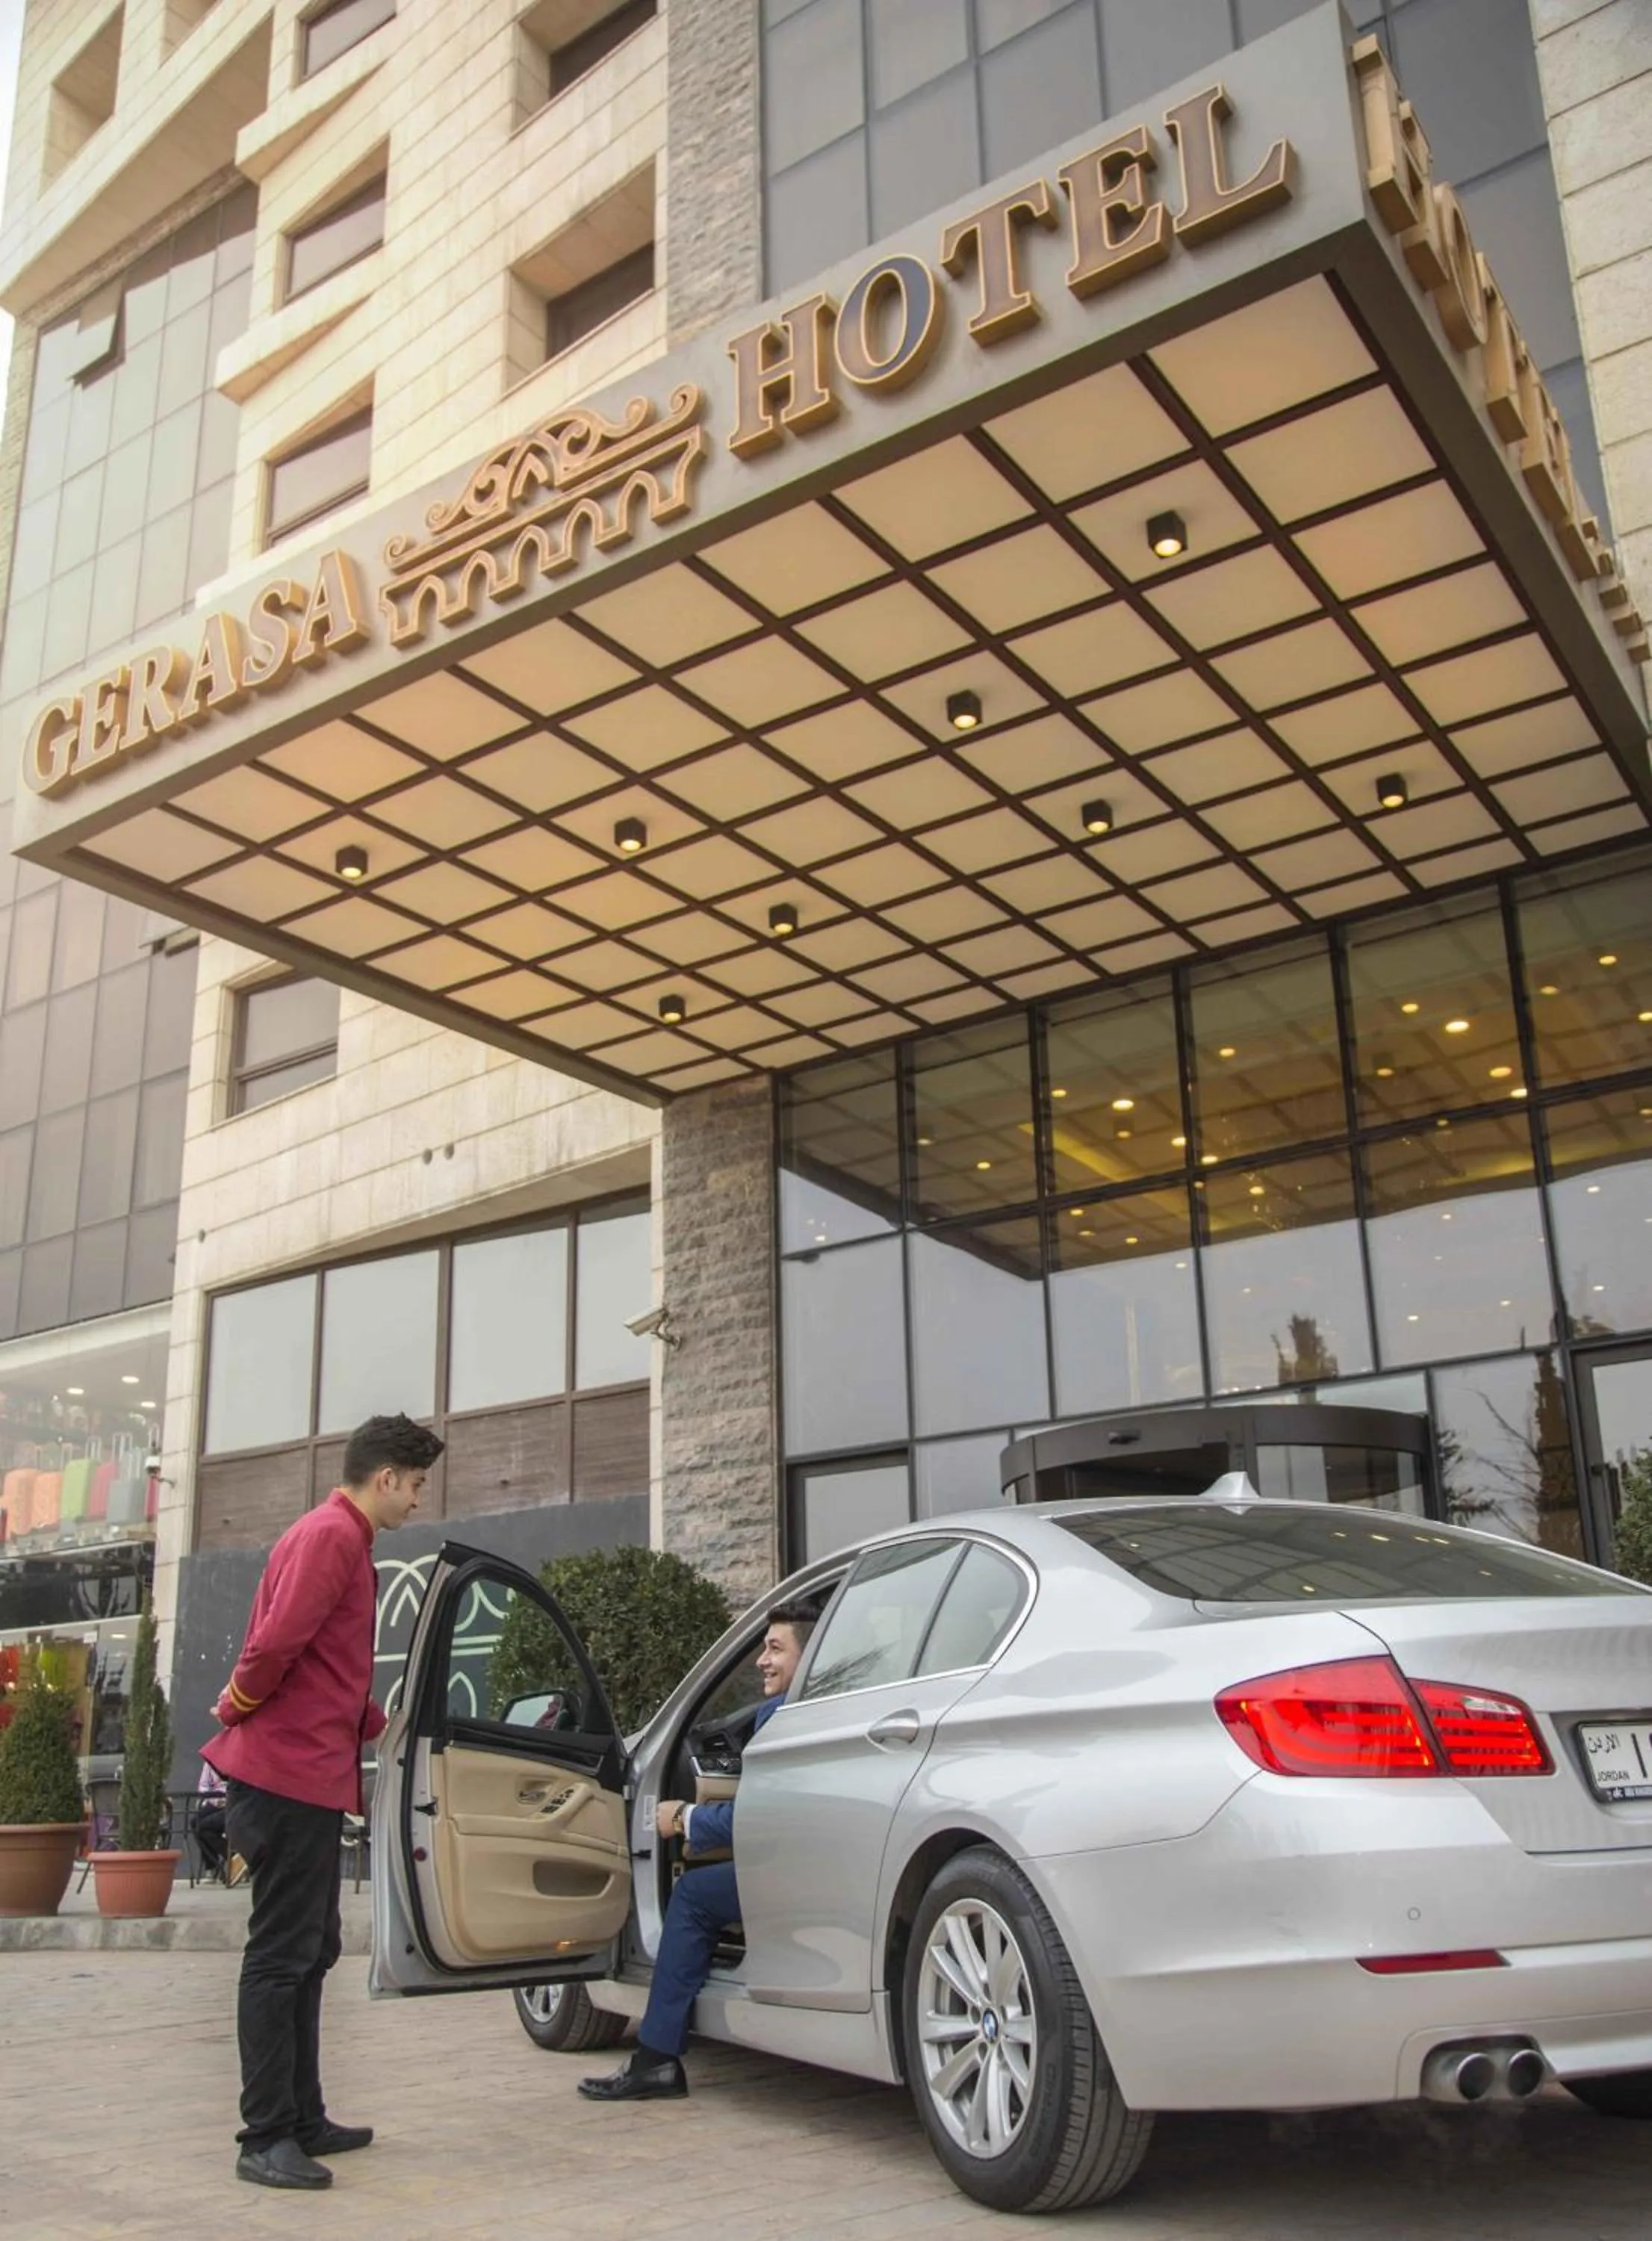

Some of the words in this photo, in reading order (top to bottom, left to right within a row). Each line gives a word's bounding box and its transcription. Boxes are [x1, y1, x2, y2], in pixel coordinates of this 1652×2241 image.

[20, 548, 369, 798] GERASA
[726, 83, 1296, 459] HOTEL
[1597, 1770, 1630, 1782] JORDAN
